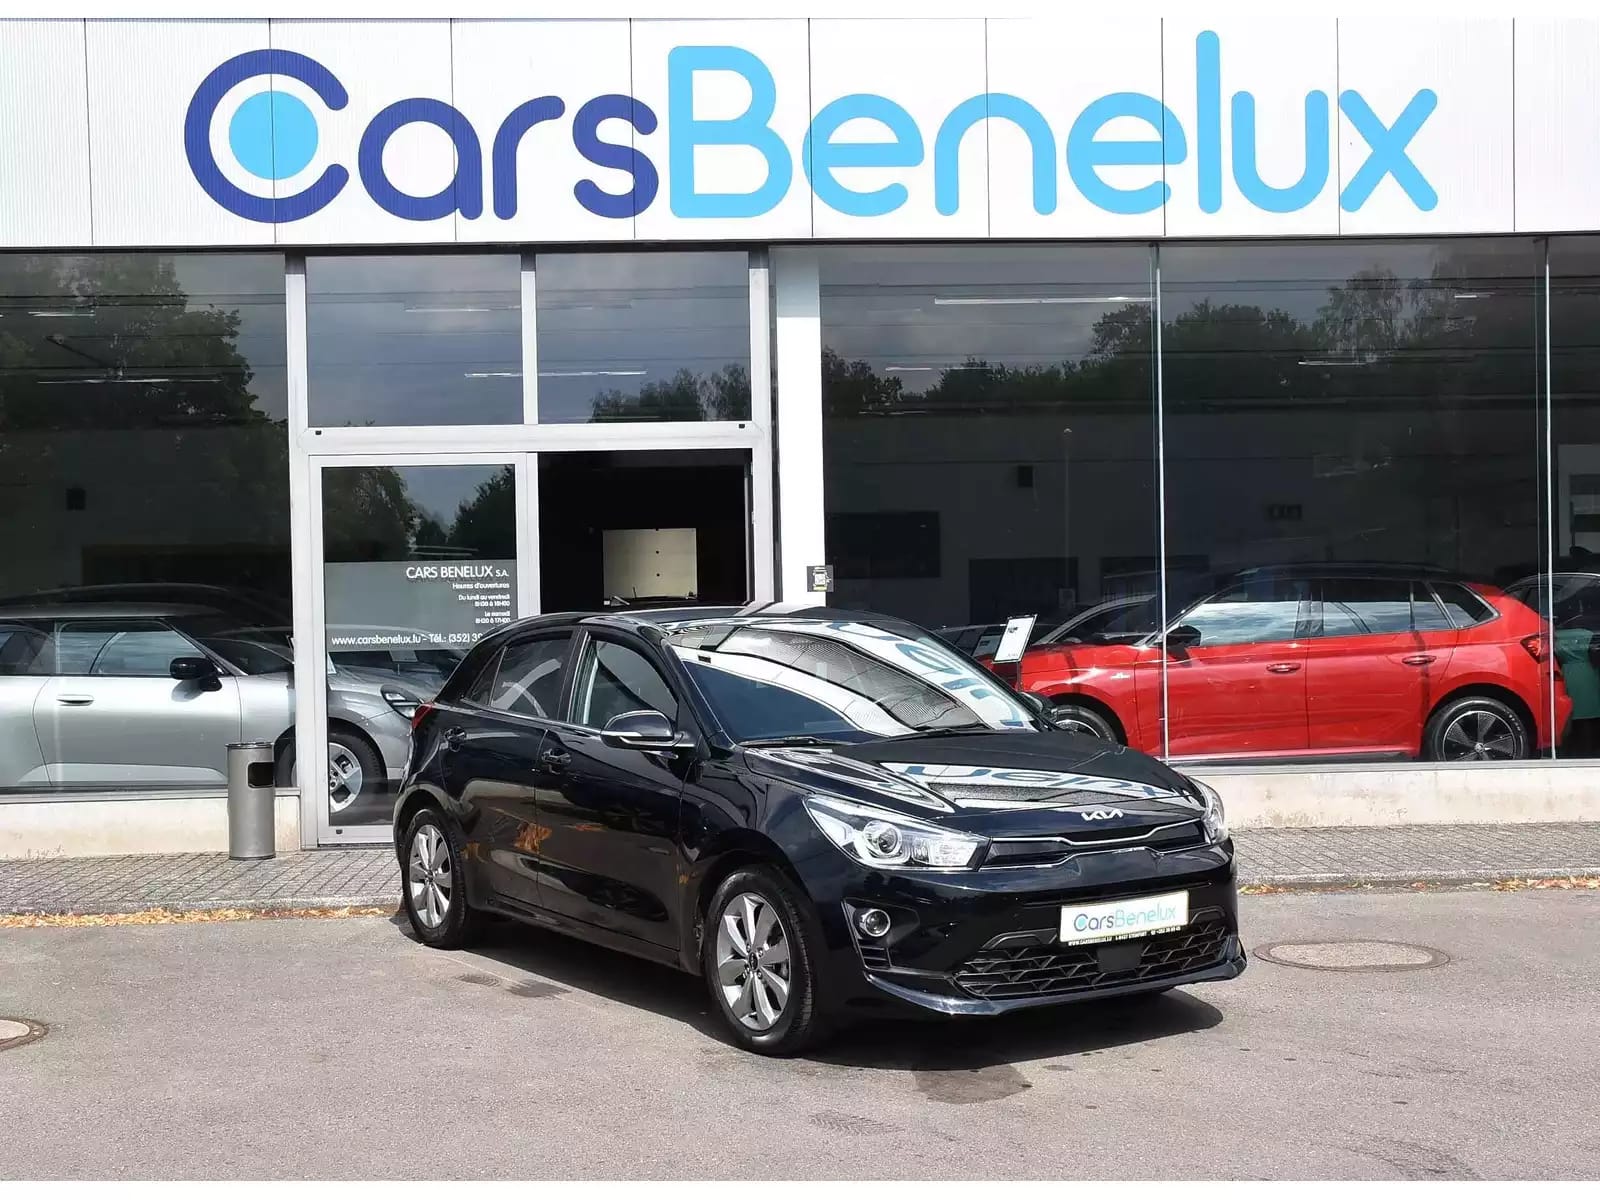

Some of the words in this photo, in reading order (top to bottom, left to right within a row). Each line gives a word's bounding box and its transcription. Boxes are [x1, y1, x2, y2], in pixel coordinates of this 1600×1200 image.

[184, 30, 1438, 223] CarsBenelux
[406, 566, 438, 579] CARS
[440, 565, 493, 578] BENELUX
[331, 633, 422, 645] www.carsbenelux.lu
[448, 631, 470, 643] (352)
[1073, 902, 1177, 932] CarsBenelux
